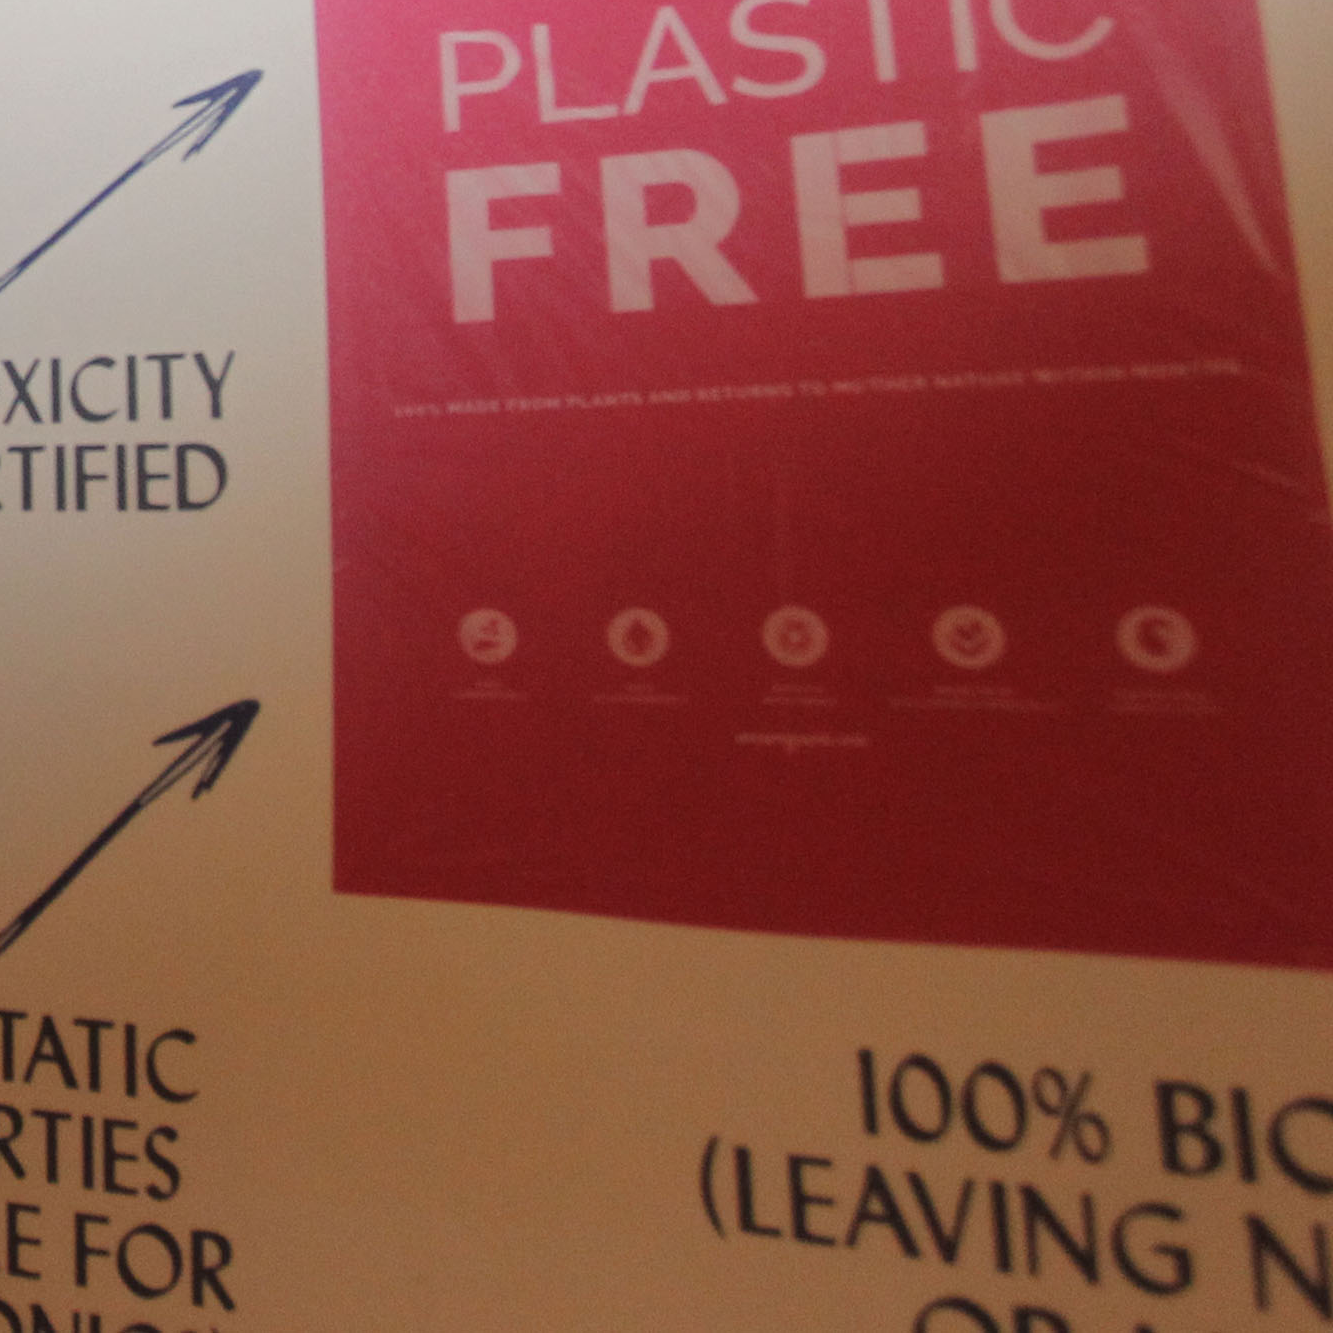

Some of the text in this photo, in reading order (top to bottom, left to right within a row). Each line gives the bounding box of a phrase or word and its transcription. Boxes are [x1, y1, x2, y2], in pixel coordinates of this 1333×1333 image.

[444, 93, 1151, 325] FREE
[856, 1047, 1111, 1165] 100%
[73, 1210, 237, 1314] FOR
[697, 1134, 1333, 1321] (LEAVING N
